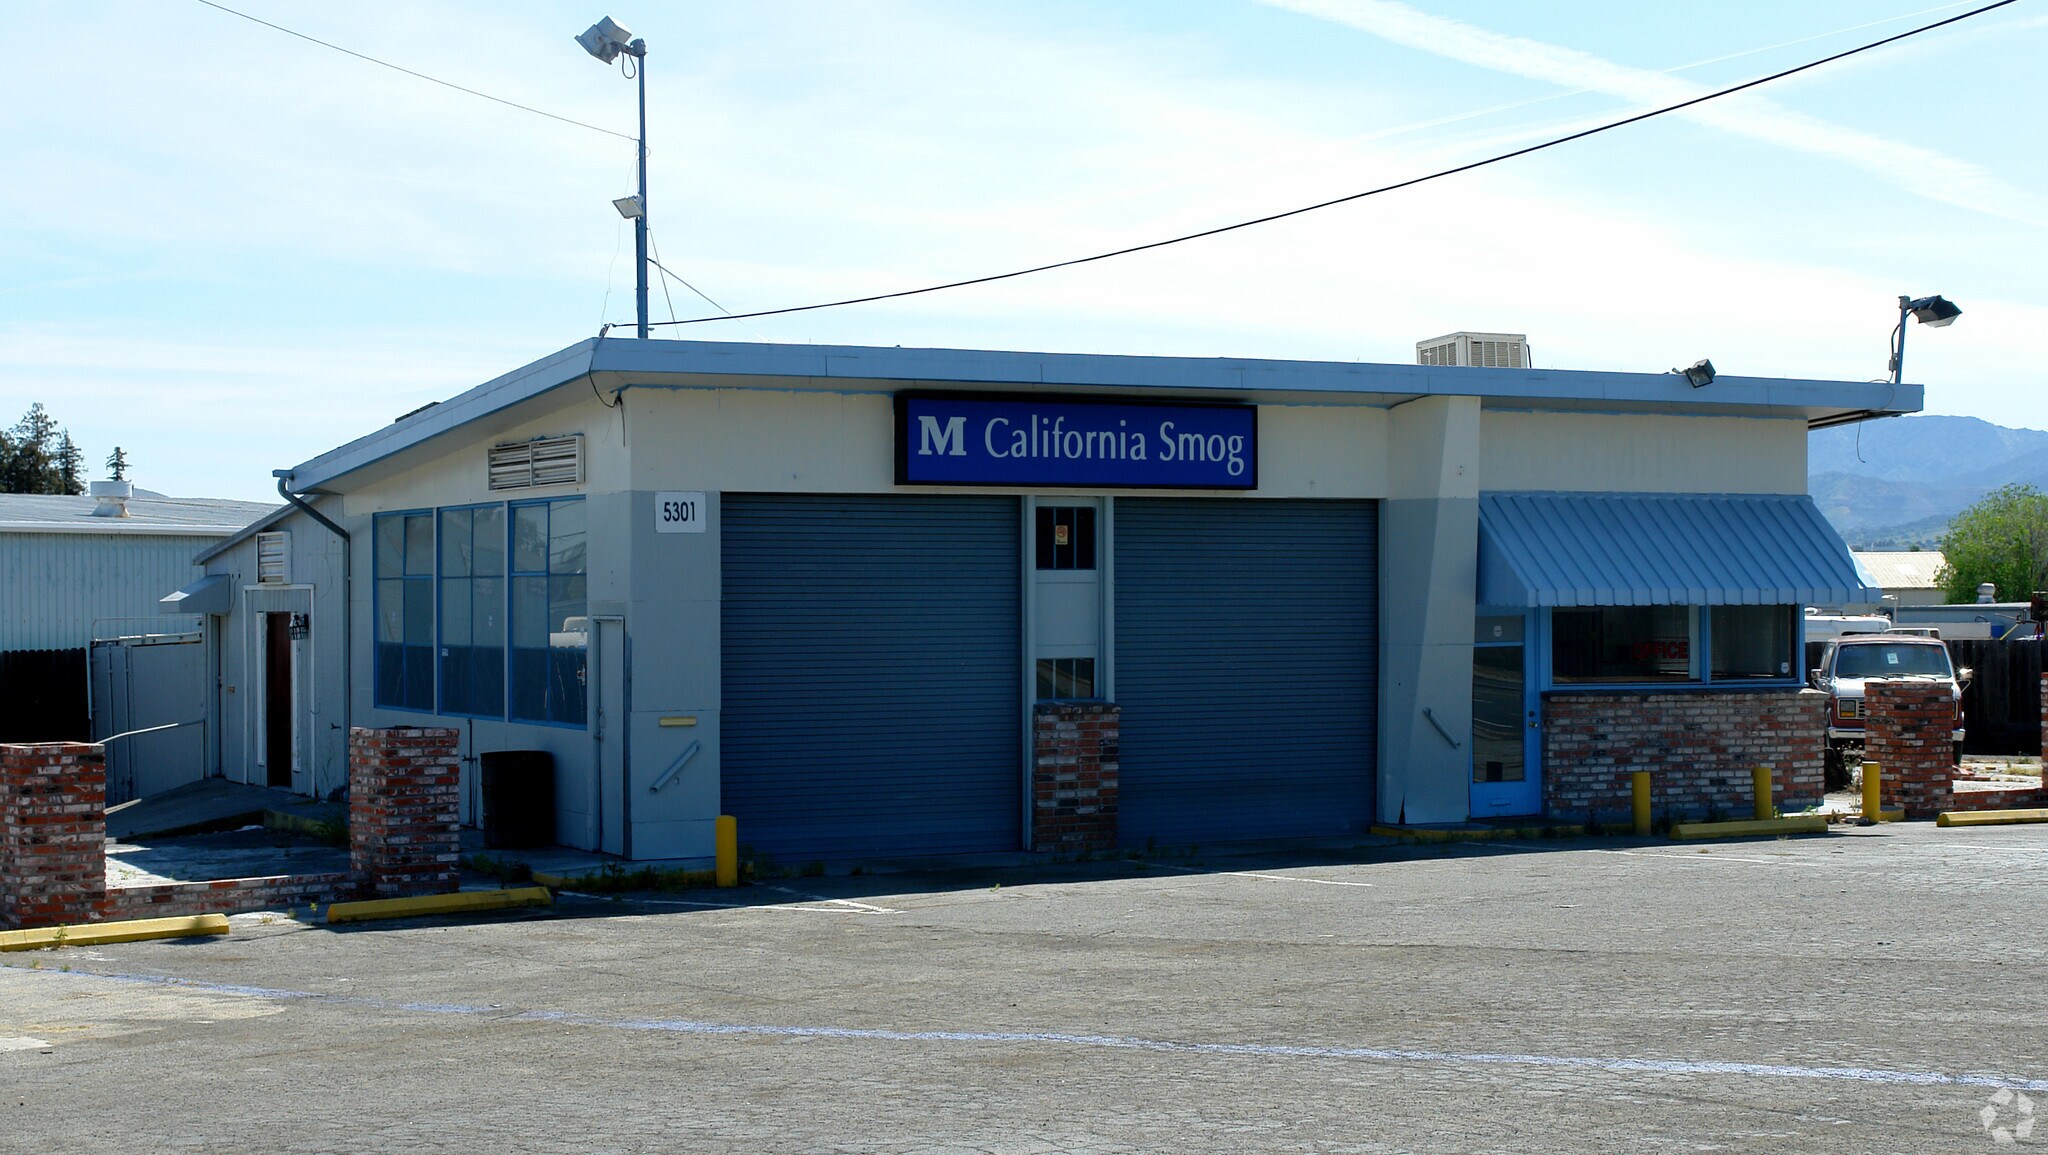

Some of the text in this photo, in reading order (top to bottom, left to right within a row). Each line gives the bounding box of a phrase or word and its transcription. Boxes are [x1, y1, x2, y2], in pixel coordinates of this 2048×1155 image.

[918, 414, 1245, 476] M California Smog
[663, 501, 695, 522] 5301
[1632, 641, 1689, 660] OFFICE
